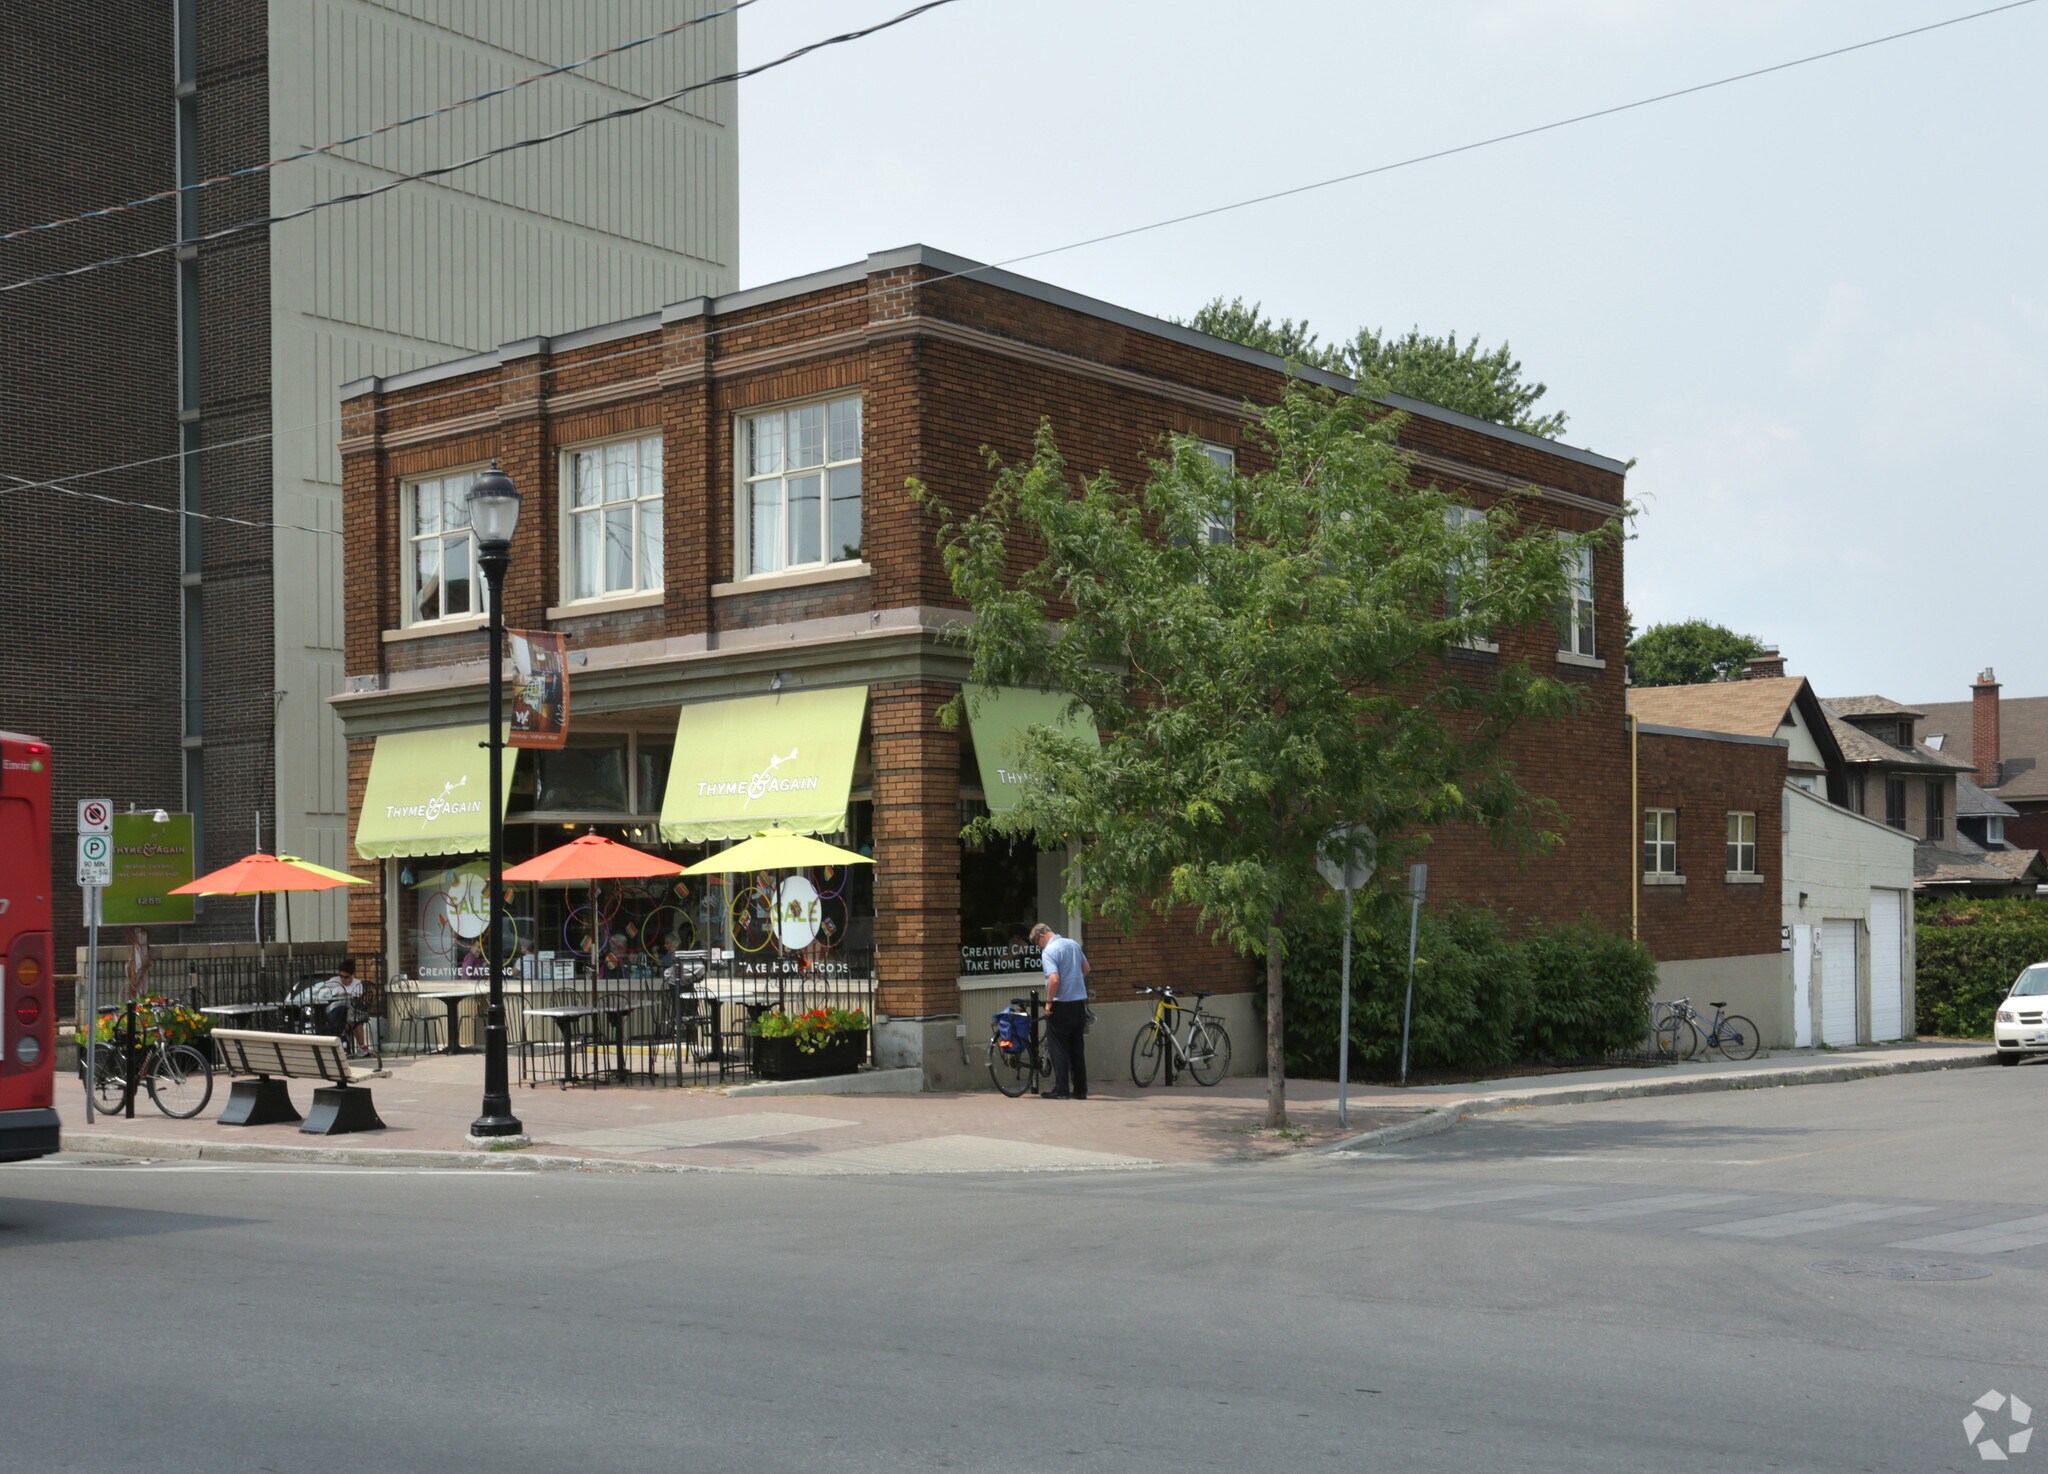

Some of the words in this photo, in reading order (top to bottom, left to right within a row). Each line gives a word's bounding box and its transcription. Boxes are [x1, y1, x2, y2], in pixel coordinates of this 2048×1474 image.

[697, 782, 748, 797] THYME
[768, 777, 818, 792] AGAIN
[386, 805, 427, 818] THYME
[442, 801, 481, 814] AGAIN
[90, 842, 100, 854] P
[449, 896, 491, 915] SALE
[772, 901, 818, 923] SALE
[962, 945, 1008, 957] CREATIVE
[1011, 944, 1043, 956] CATER
[419, 966, 463, 977] CREATIVE
[466, 966, 513, 977] CATENG
[965, 959, 990, 971] TAKE
[993, 958, 1020, 970] HOME
